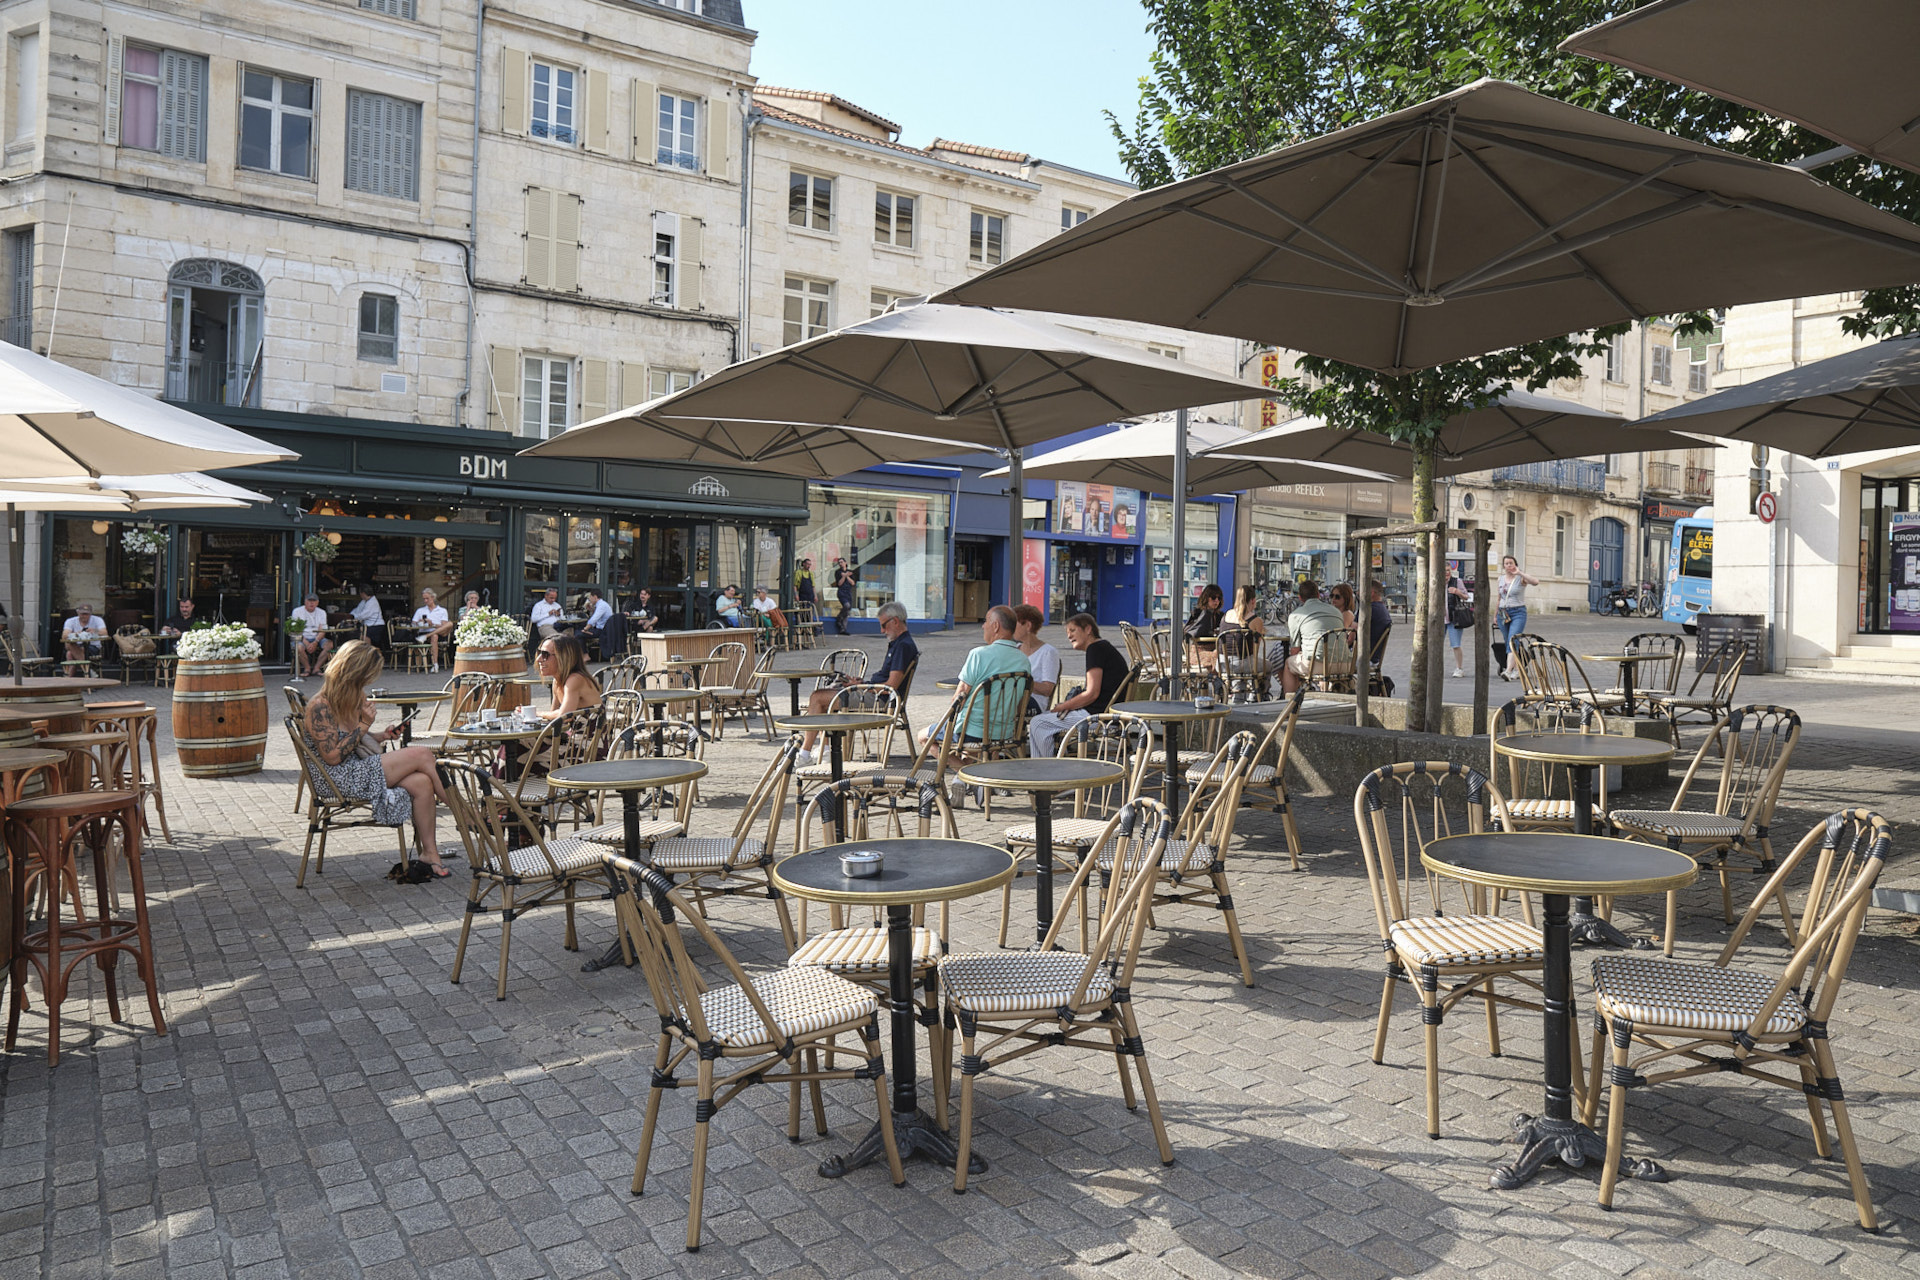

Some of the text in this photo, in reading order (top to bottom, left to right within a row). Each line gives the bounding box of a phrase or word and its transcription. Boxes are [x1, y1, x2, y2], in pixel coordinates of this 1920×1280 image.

[460, 454, 507, 480] BDM
[1295, 483, 1325, 497] REFLEX
[575, 530, 594, 540] BDM
[760, 540, 777, 550] BDM
[1689, 539, 1712, 549] ÉLECT
